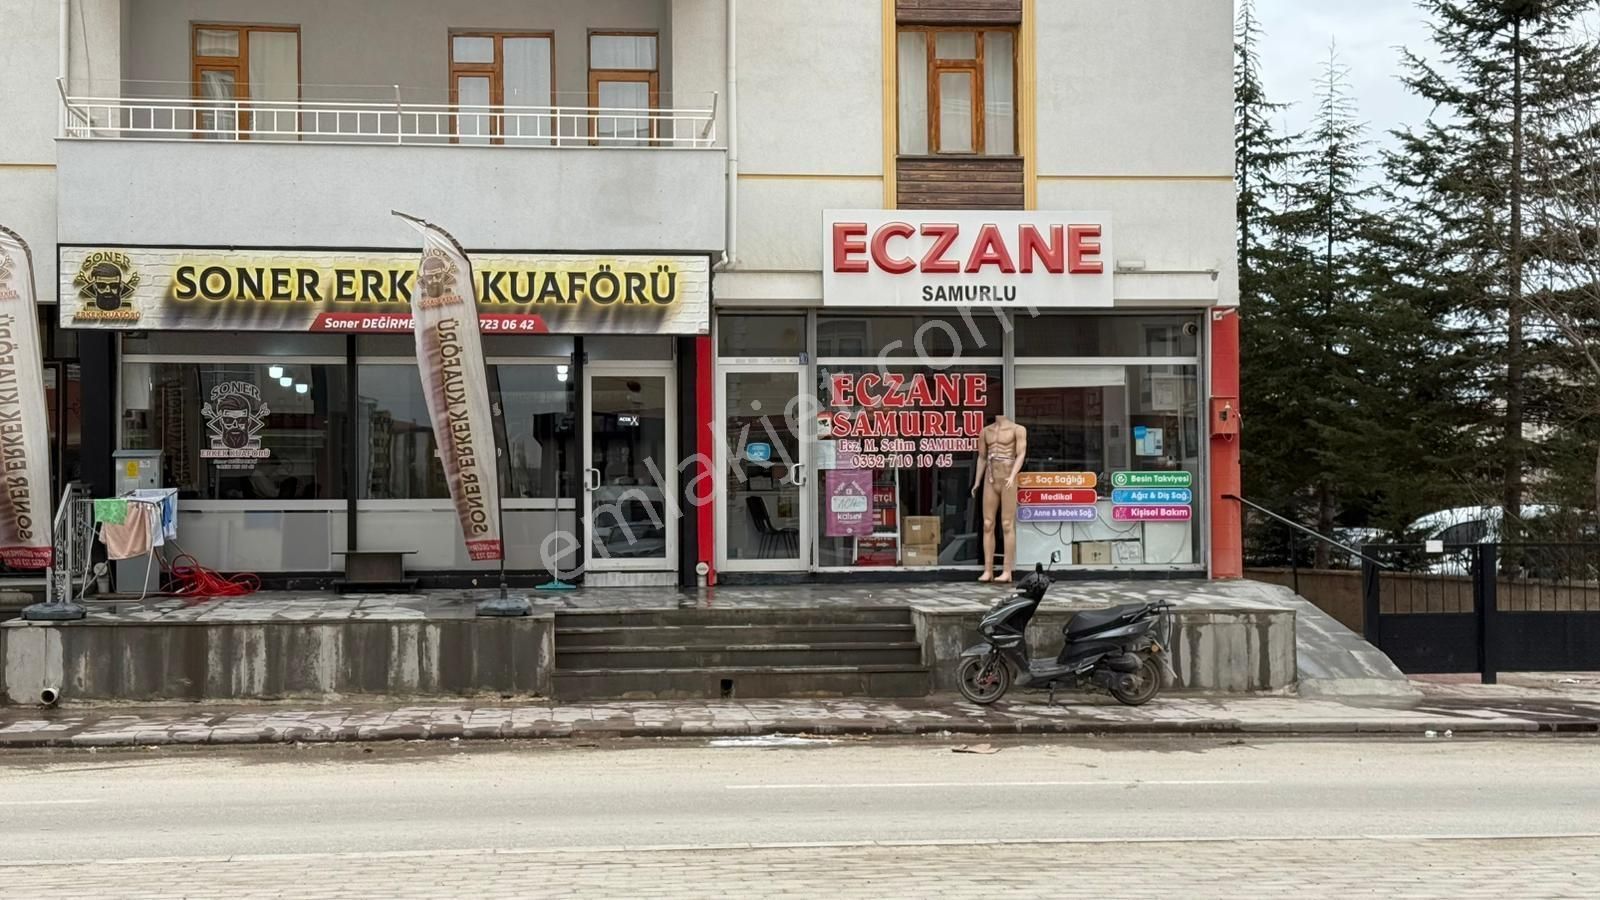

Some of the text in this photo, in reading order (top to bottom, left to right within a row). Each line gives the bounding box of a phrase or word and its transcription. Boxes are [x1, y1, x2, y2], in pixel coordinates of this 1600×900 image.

[833, 221, 1103, 274] ECZANE
[84, 251, 130, 269] SONER
[175, 264, 677, 305] SONER ERK KUAFÖRÜ
[922, 285, 1017, 302] SAMURLU
[325, 315, 535, 331] Soner DEĞİRME 723 06 42
[210, 381, 262, 401] SONER
[830, 373, 987, 407] ECZANE
[832, 411, 983, 437] SAMURLU
[838, 438, 862, 453] Ecz.
[864, 438, 878, 452] M.
[880, 438, 916, 452] Selim
[852, 453, 953, 468] 0332 710 10 45
[1035, 474, 1086, 485] Saç Sağlığı
[1130, 474, 1189, 484] Besin Takviyesi
[1040, 493, 1073, 501] Medikal
[1131, 492, 1149, 501] Ağız
[1157, 493, 1170, 502] Diş
[1171, 491, 1189, 501] Sağ.
[1033, 508, 1093, 519] Anne & Bebek Sağ.
[1130, 508, 1188, 518] Kişisel Bakım
